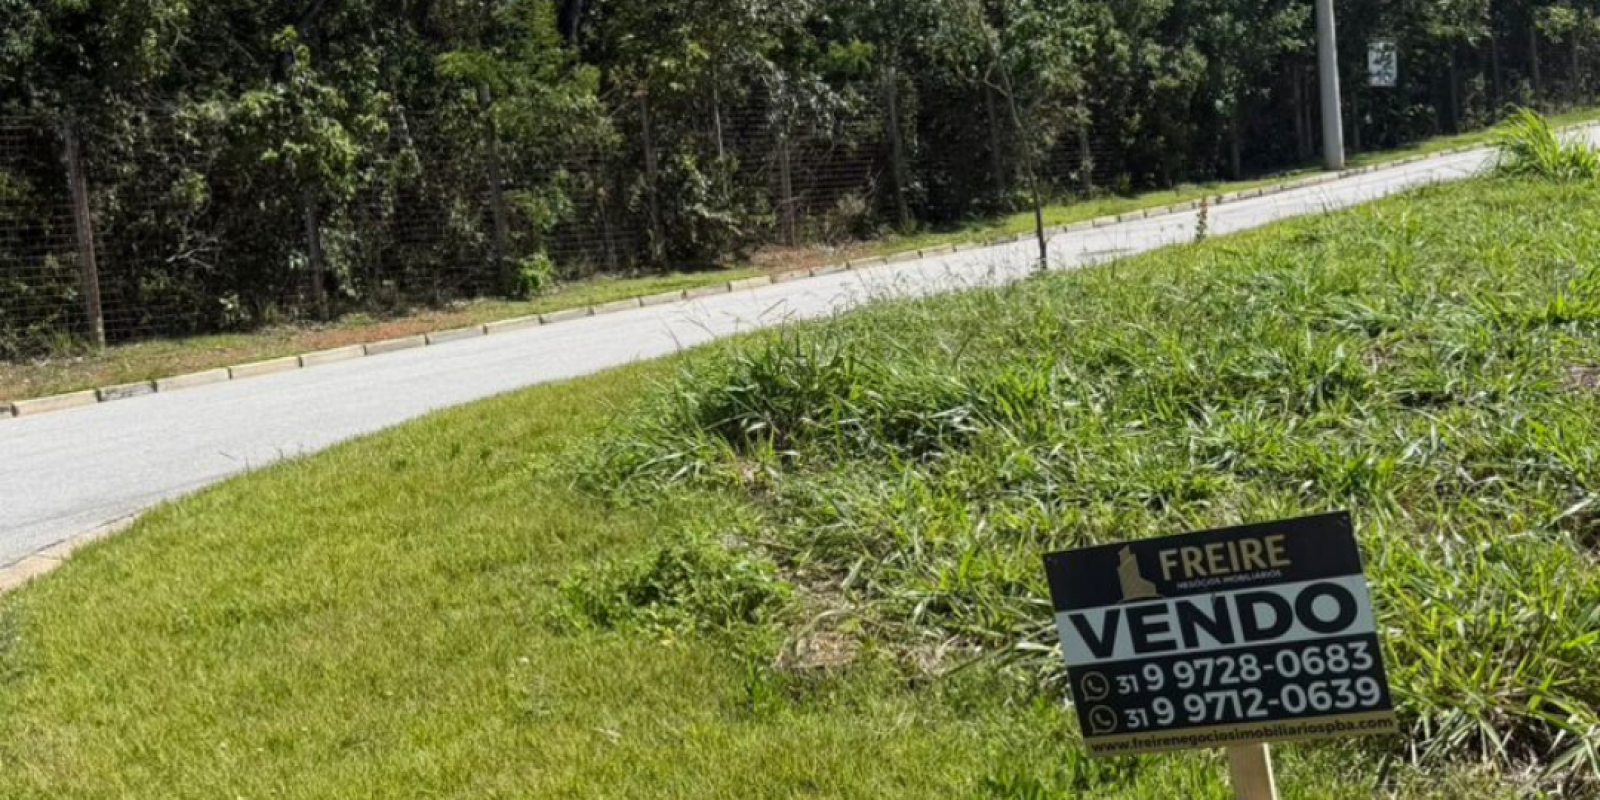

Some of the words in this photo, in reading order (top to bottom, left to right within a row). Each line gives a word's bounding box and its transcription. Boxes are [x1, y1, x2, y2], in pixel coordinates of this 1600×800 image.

[1159, 534, 1292, 580] FREIRE
[1068, 581, 1358, 659] VENDO
[1116, 674, 1139, 694] 31
[1142, 663, 1165, 691] 9
[1173, 640, 1373, 688] 9728-0683
[1124, 707, 1149, 728] 31
[1152, 697, 1175, 726] 9
[1183, 676, 1381, 723] 9712-0639
[1091, 717, 1394, 752] www.freirenegociosimobiliariospba.com
